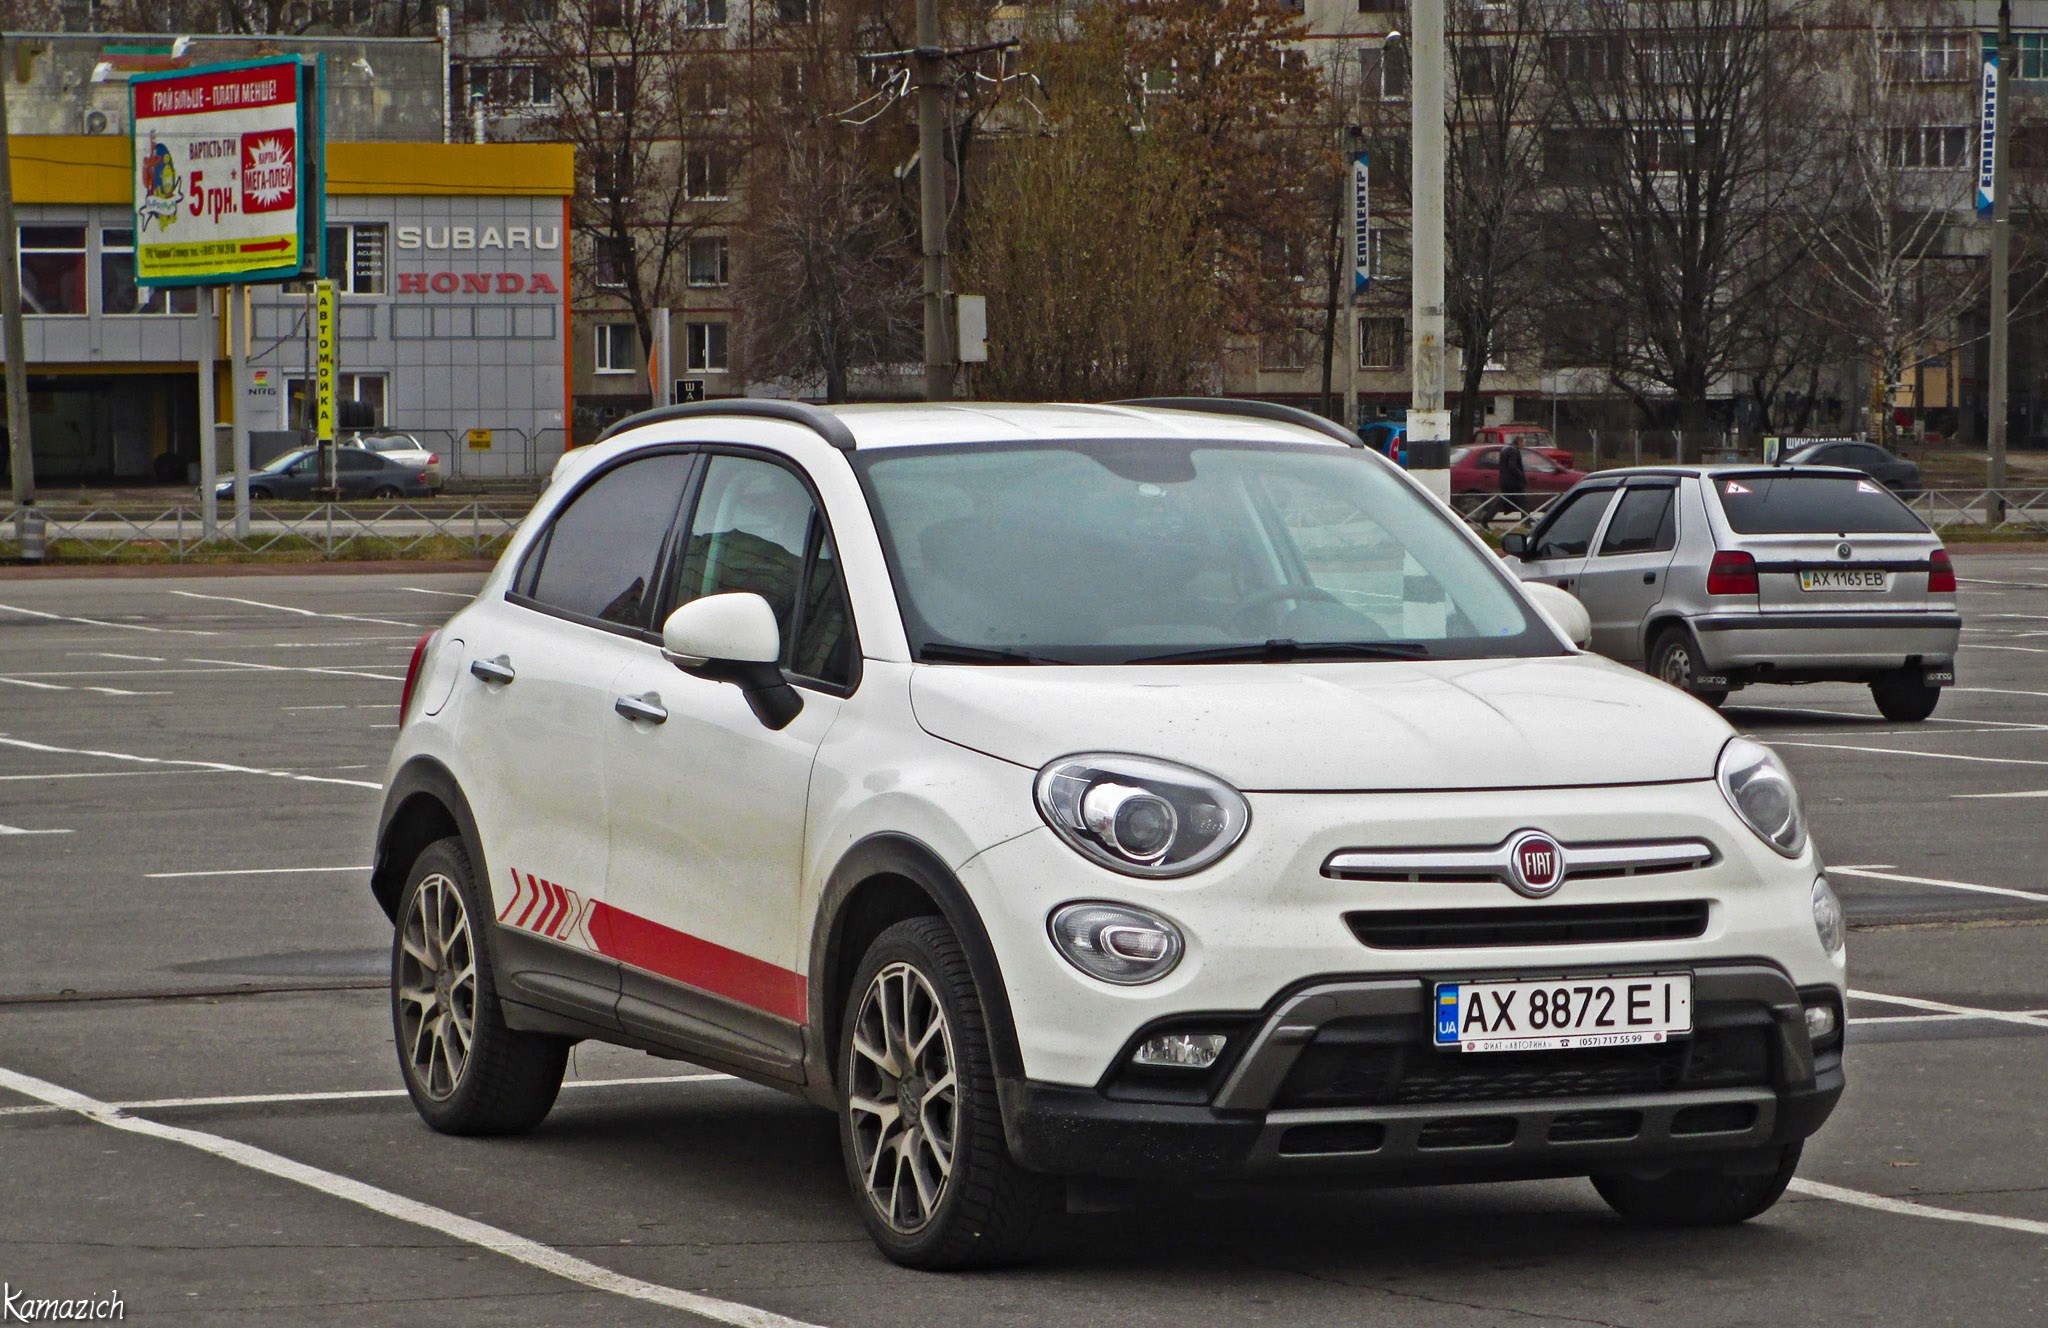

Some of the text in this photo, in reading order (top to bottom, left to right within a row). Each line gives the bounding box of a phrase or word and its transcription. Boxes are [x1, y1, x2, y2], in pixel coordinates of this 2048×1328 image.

[153, 88, 173, 112] ГРАЙ
[174, 88, 204, 110] БІЛЬШЕ
[212, 84, 240, 106] ПЛАТИ
[242, 80, 277, 103] МЕНШЕ!
[1981, 74, 1997, 187] ЕПІЦЕНТР
[189, 139, 236, 160] ВАРТІСТЬ ГРИ
[245, 162, 292, 192] МЕГА-ПЛЕЙ
[189, 170, 204, 217] 5
[1356, 171, 1367, 267] ЕПІЦЕНТР
[397, 226, 559, 249] SUBARU
[398, 272, 559, 293] HONDA
[319, 297, 330, 420] АВТОМОЙКА
[248, 388, 277, 396] NRG
[1812, 572, 1831, 586] AX
[1833, 572, 1862, 586] 1165
[1864, 572, 1884, 586] EB
[1524, 852, 1551, 876] FIAT
[1462, 983, 1671, 1033] AX 8872 EI
[1439, 1021, 1457, 1034] UA
[1483, 1041, 1503, 1050] ФИАТ
[1579, 1038, 1601, 1047] (057)
[1603, 1036, 1618, 1045] 717
[1620, 1036, 1630, 1044] 55
[1632, 1034, 1643, 1043] 99
